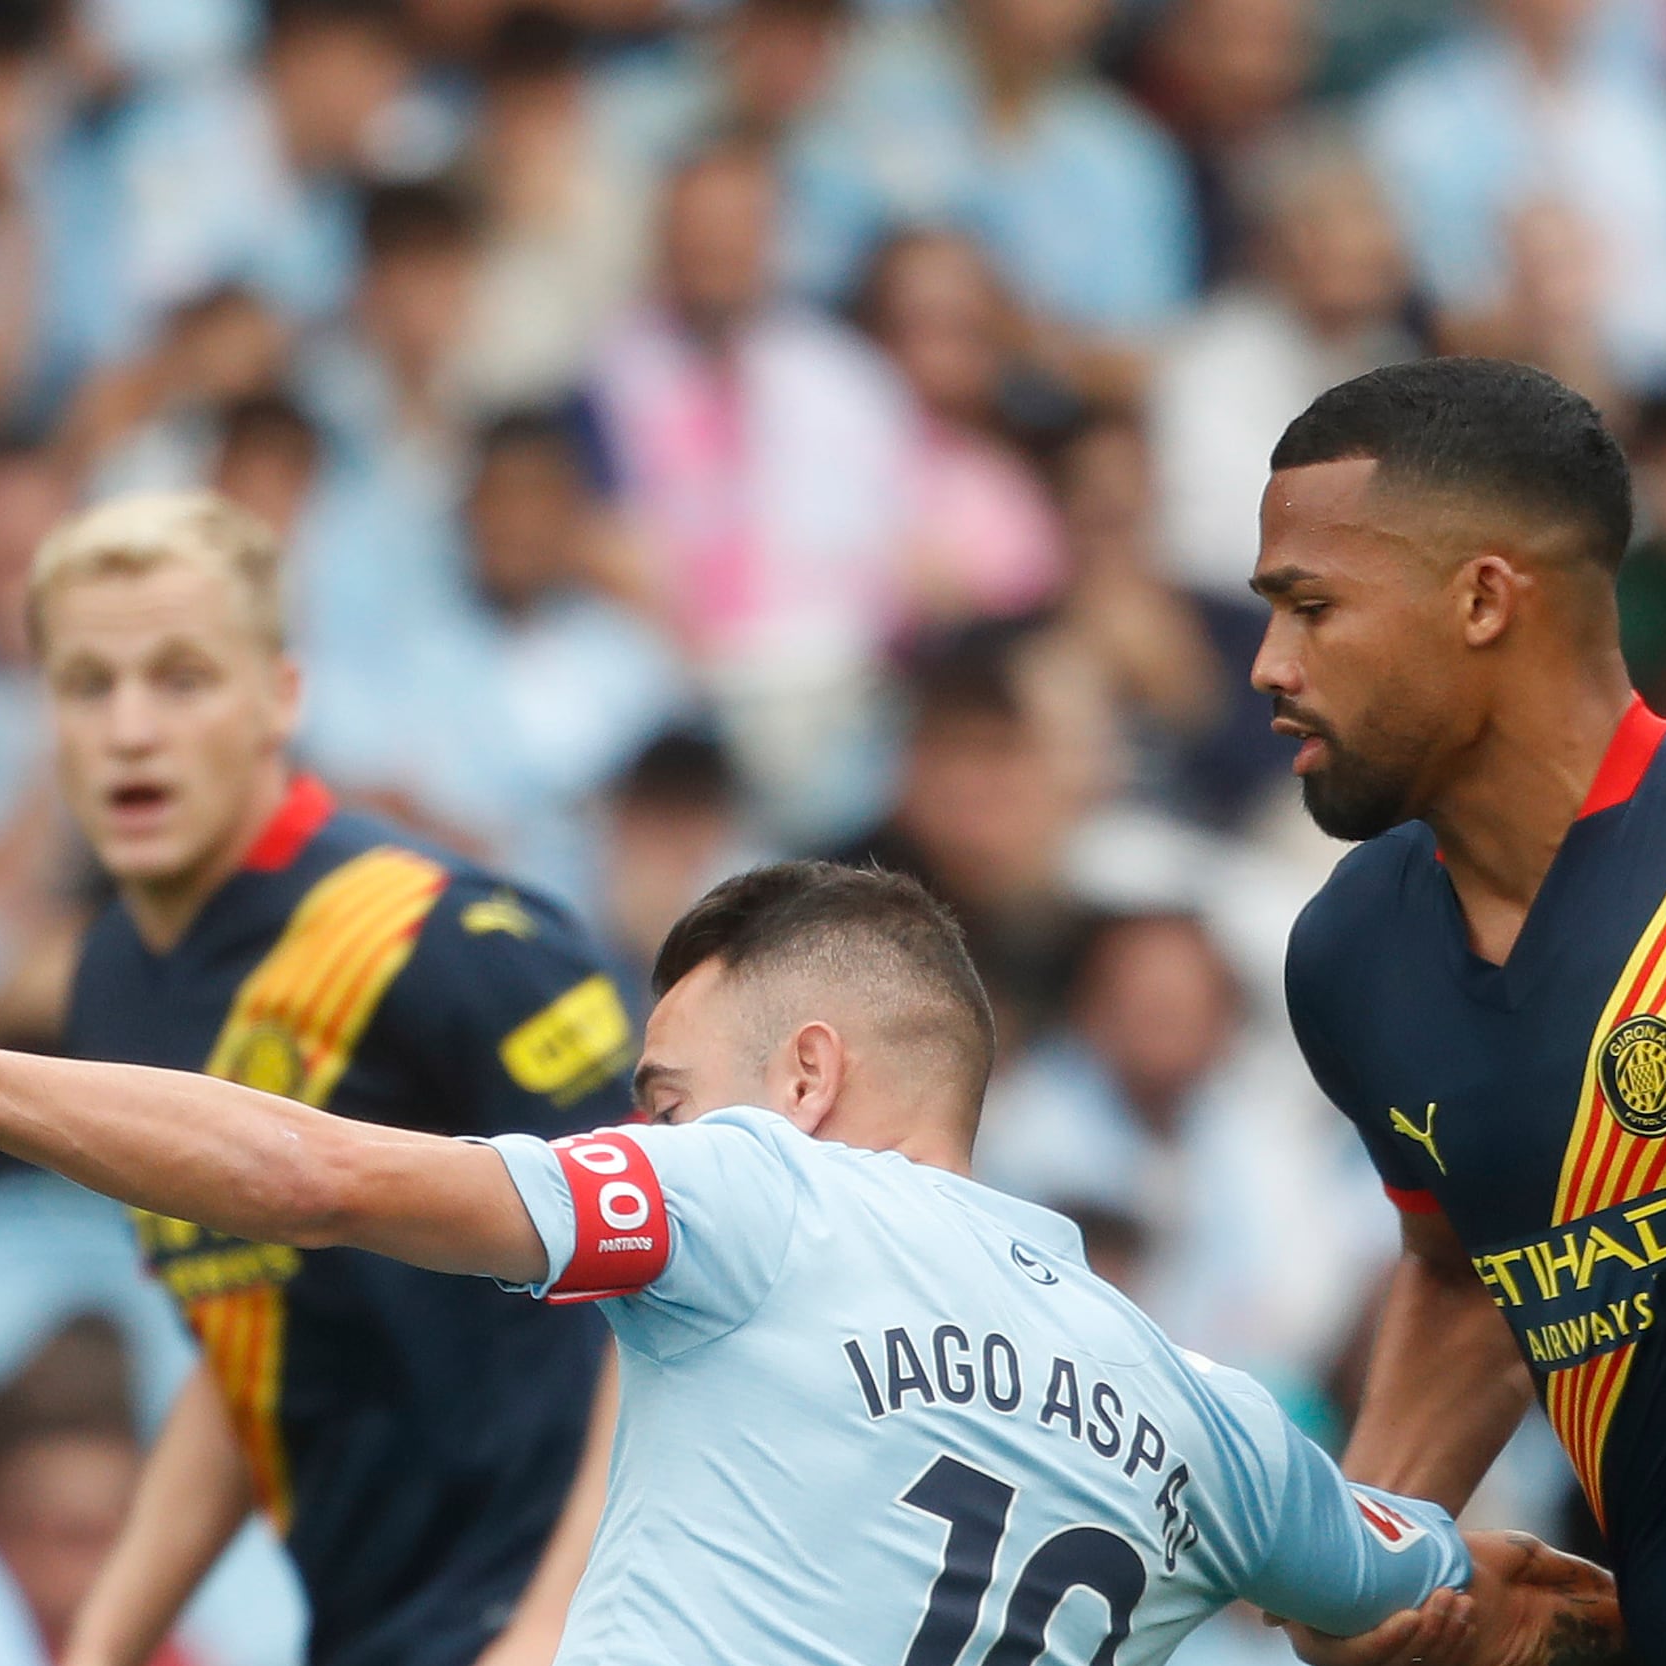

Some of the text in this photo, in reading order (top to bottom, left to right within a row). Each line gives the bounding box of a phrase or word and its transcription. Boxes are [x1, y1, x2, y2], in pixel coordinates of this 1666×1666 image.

[597, 1236, 653, 1253] PARTIDOS
[1525, 1292, 1656, 1363] AIRWAYS
[842, 1323, 1024, 1421] IAGO
